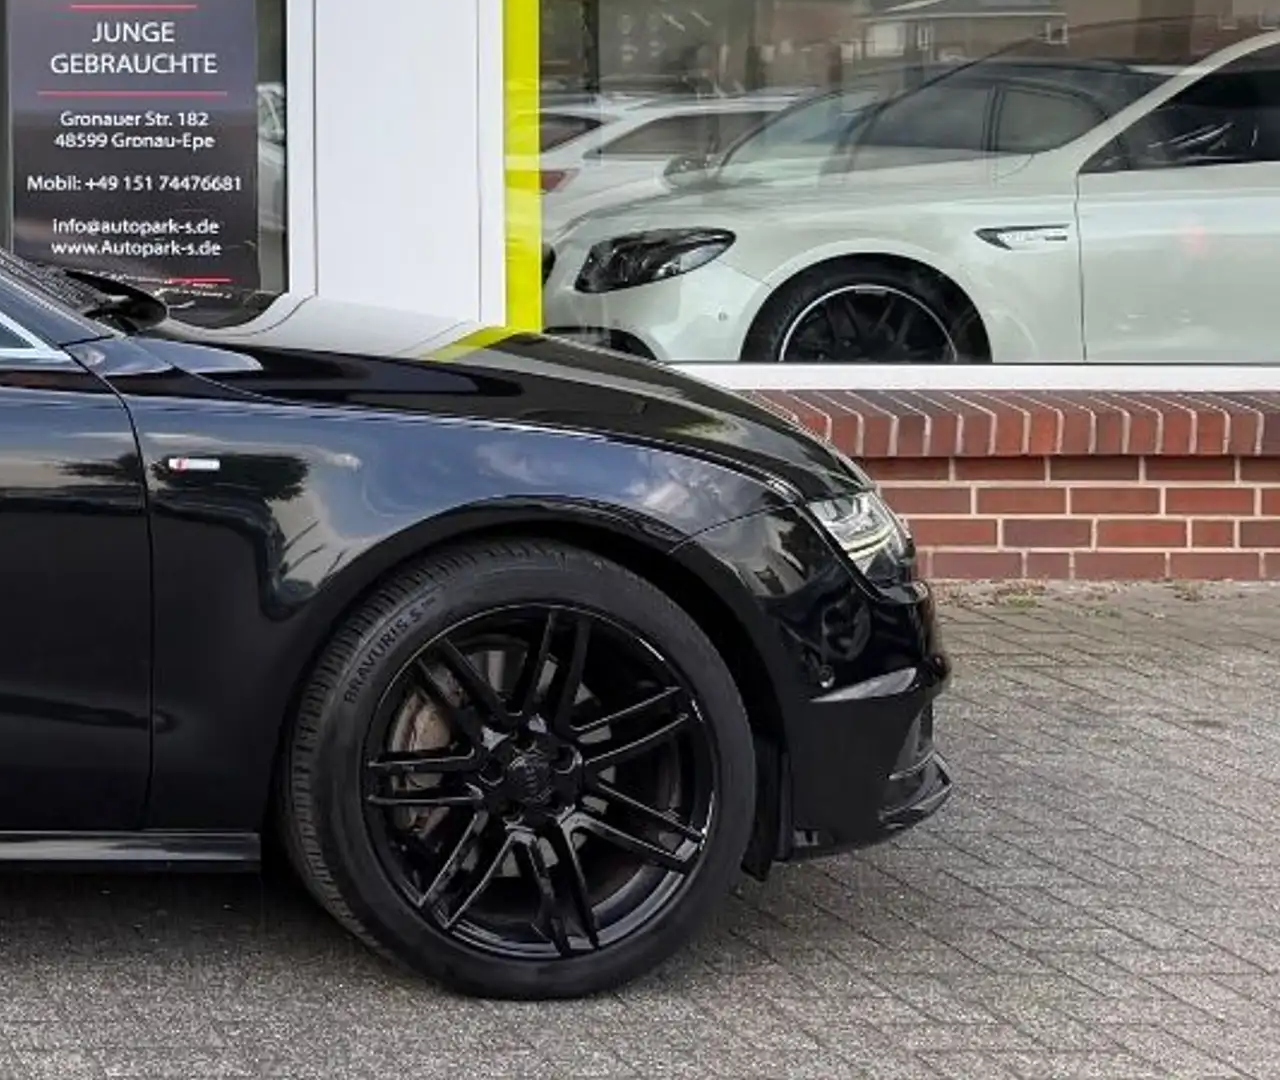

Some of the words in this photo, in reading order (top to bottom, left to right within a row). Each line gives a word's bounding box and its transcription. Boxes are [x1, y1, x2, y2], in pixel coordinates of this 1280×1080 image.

[92, 22, 175, 42] JUNGE
[50, 53, 218, 74] GEBRAUCHTE
[60, 111, 141, 126] Gronauer
[144, 111, 173, 127] Str.
[179, 112, 209, 126] 182
[54, 133, 108, 148] 48599
[111, 133, 216, 151] Gronau-Epe
[27, 176, 81, 191] Mobil:
[85, 176, 119, 191] +49
[124, 176, 153, 191] 151
[159, 176, 242, 191] 74476681
[51, 240, 222, 257] www.Autopark-s.de
